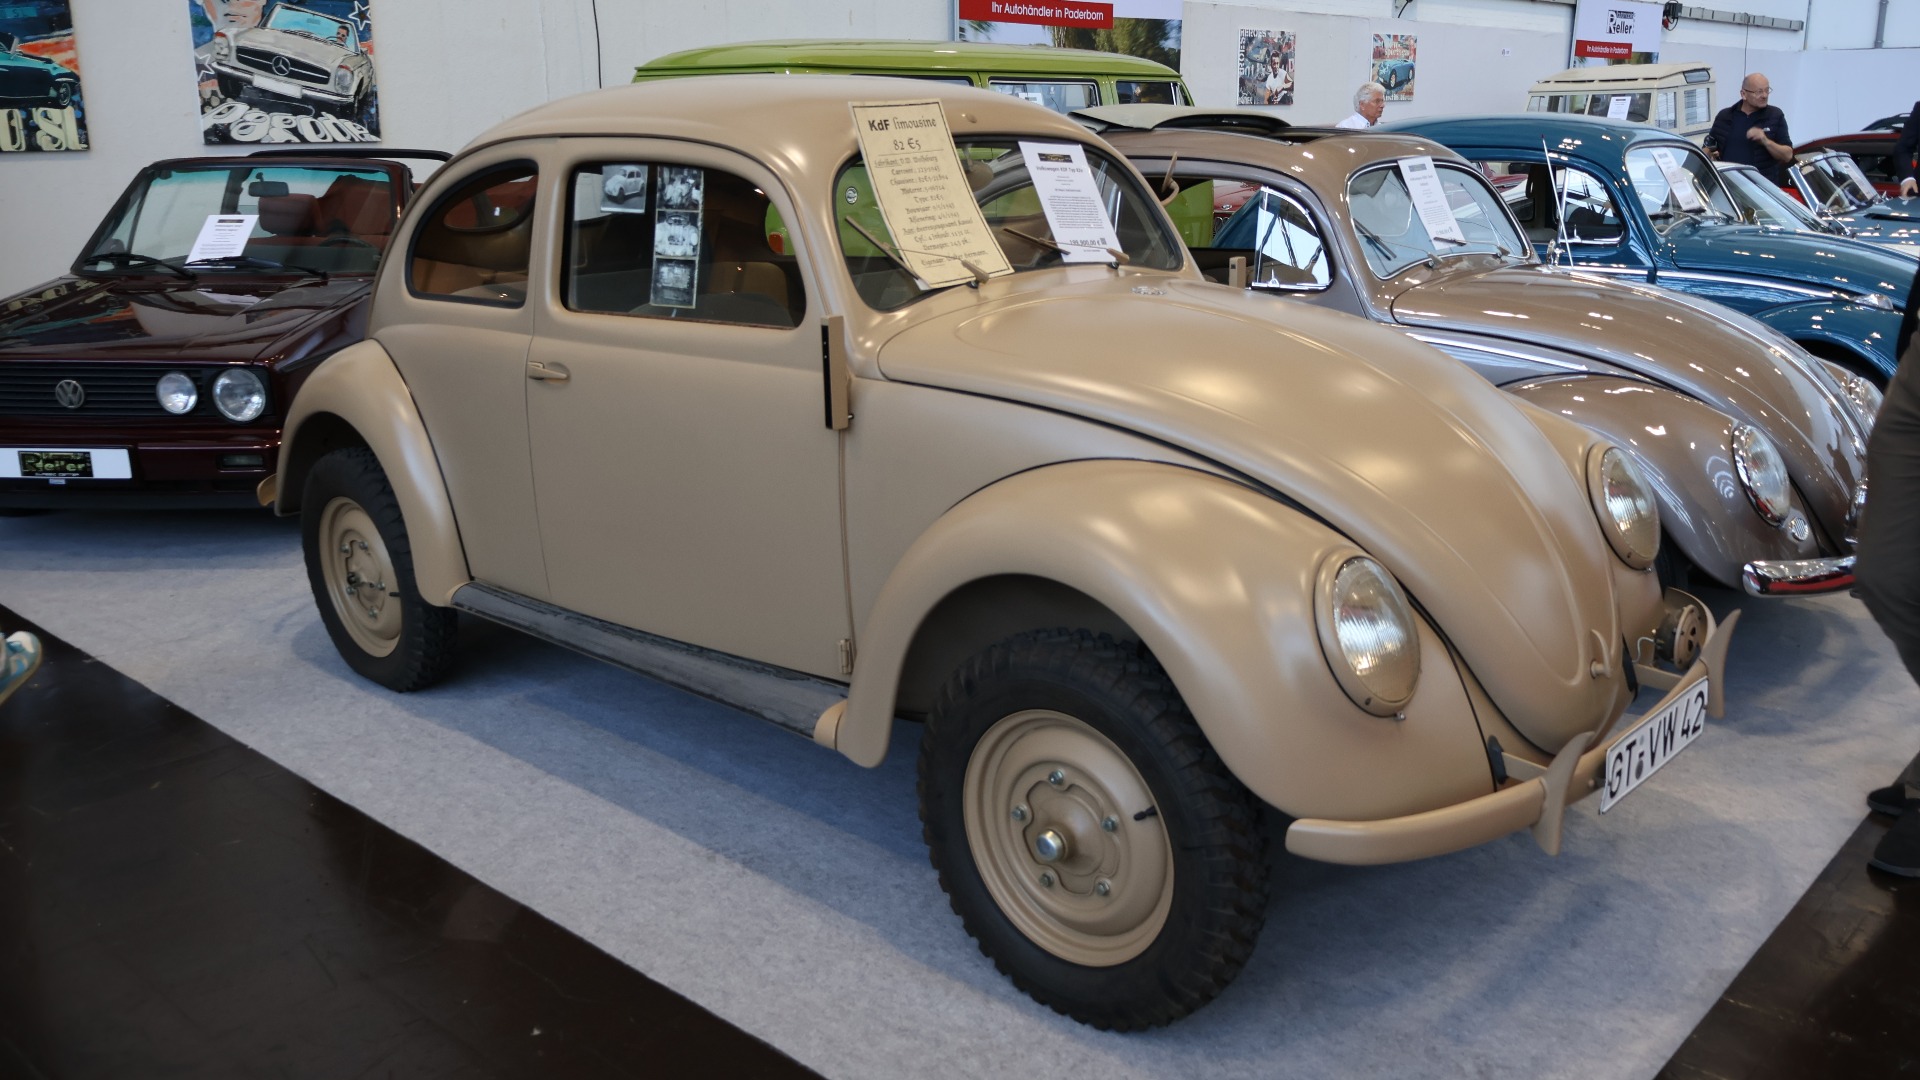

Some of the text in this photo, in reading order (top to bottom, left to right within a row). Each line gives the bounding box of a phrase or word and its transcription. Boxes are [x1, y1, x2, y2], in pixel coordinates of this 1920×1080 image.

[991, 2, 1104, 21] Ihr Autohändler in Paderborn
[868, 116, 937, 131] KdF limousine
[893, 139, 905, 151] 82
[1681, 690, 1705, 740] 42
